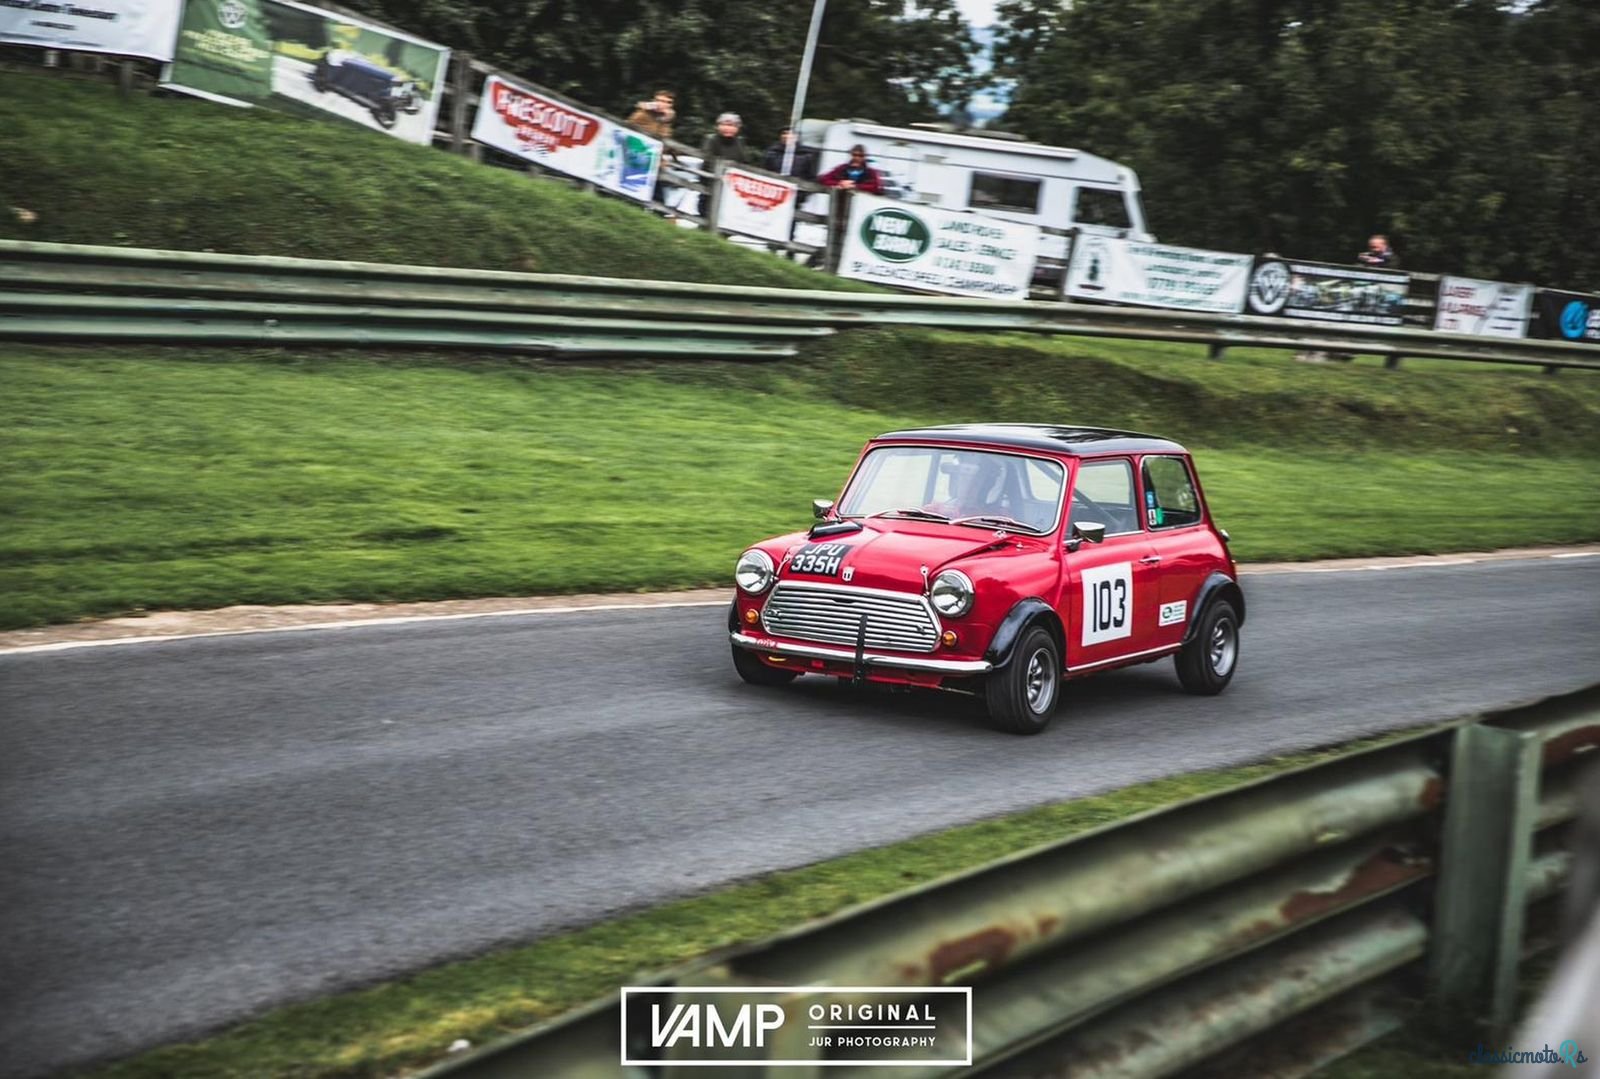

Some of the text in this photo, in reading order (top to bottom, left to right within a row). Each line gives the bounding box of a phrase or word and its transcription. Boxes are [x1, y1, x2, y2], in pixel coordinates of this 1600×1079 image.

[496, 89, 590, 141] PRESCOTT
[791, 555, 841, 575] 335H
[805, 544, 845, 556] JPU
[1092, 578, 1127, 633] 103
